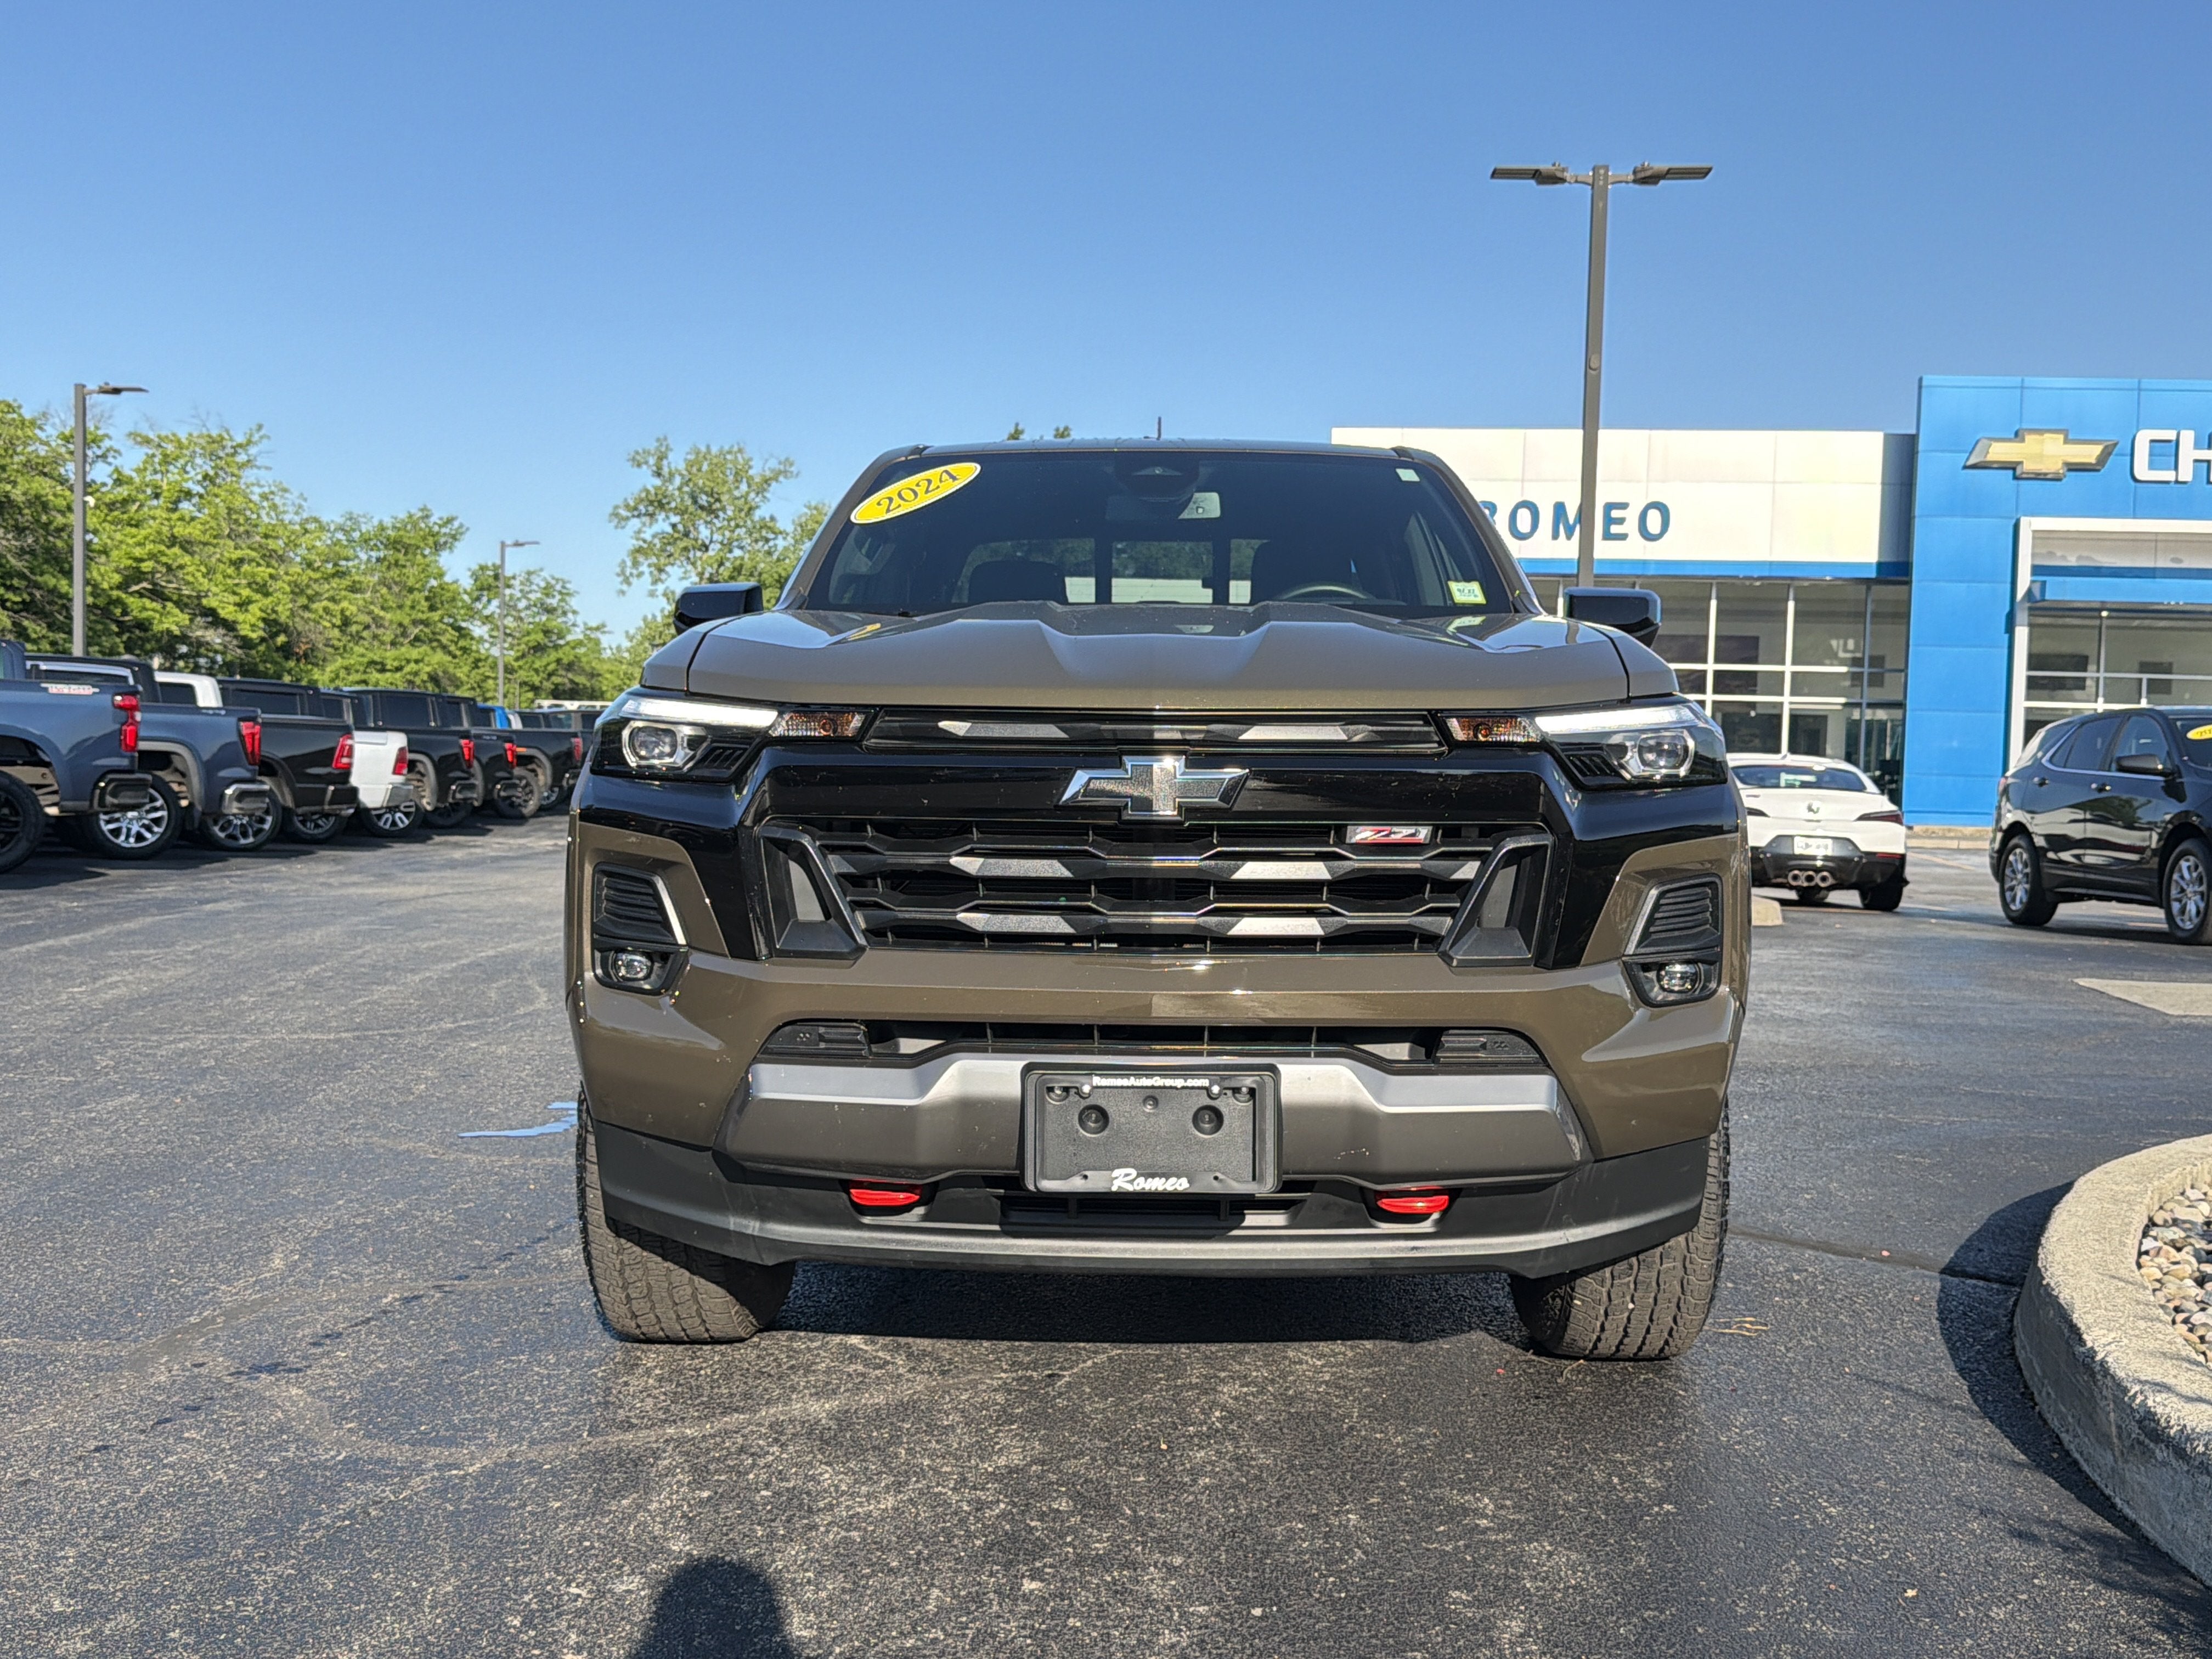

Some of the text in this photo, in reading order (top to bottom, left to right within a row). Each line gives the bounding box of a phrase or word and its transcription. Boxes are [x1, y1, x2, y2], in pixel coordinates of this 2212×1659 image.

[876, 469, 962, 515] 2024
[1352, 826, 1429, 844] Z71
[1092, 1076, 1210, 1088] RomeoAutoGroup.com
[1111, 1167, 1190, 1192] Romeo
